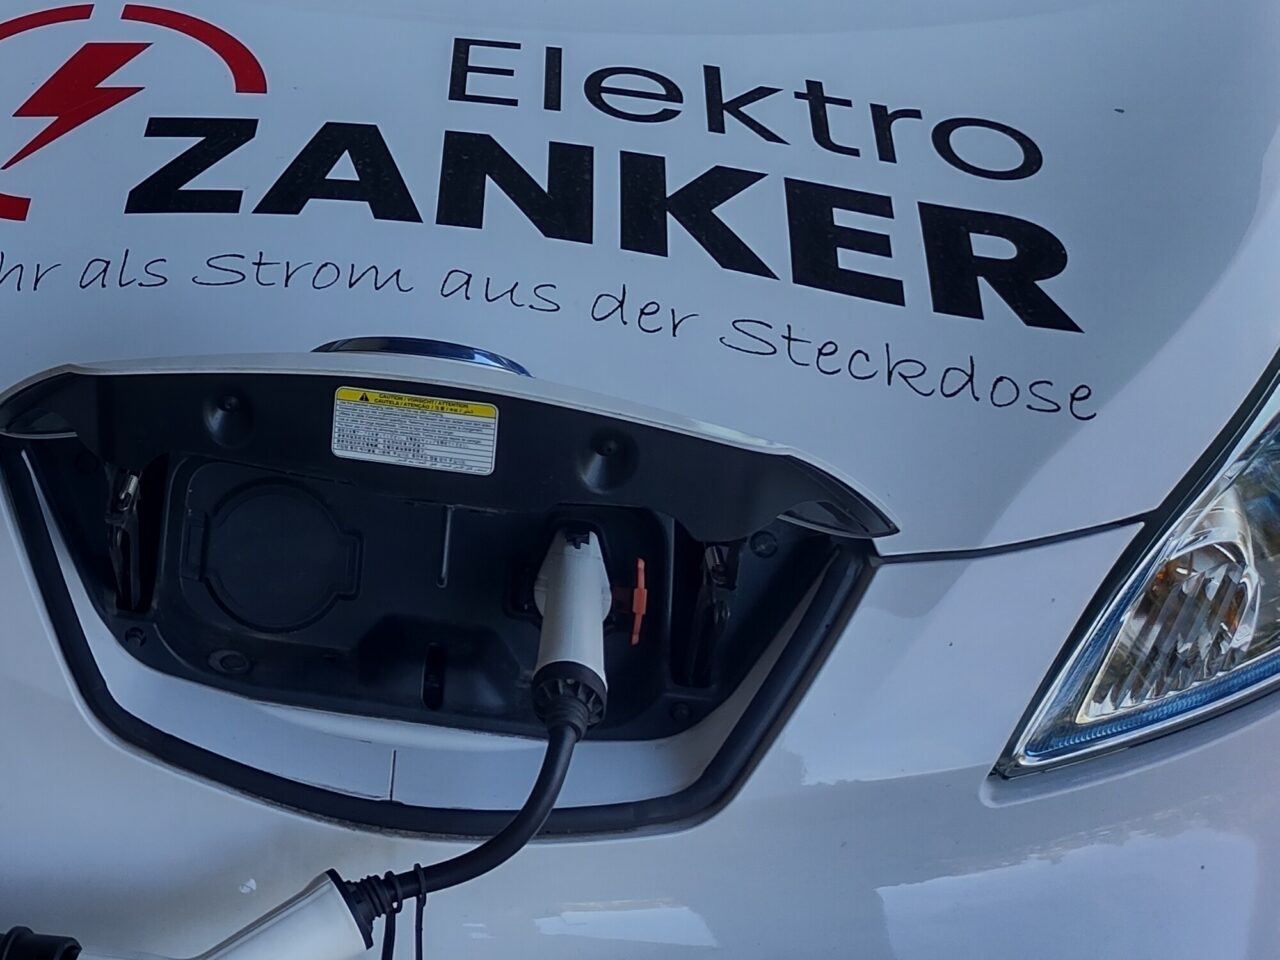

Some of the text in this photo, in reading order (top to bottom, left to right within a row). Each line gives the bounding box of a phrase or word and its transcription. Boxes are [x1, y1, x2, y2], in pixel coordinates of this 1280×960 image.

[448, 37, 1044, 181] Elektro
[124, 116, 1085, 334] ZANKER
[79, 248, 168, 290] als
[191, 251, 414, 293] Strom
[440, 268, 561, 313] aus
[590, 283, 699, 338] der
[719, 319, 1097, 421] Steckdose
